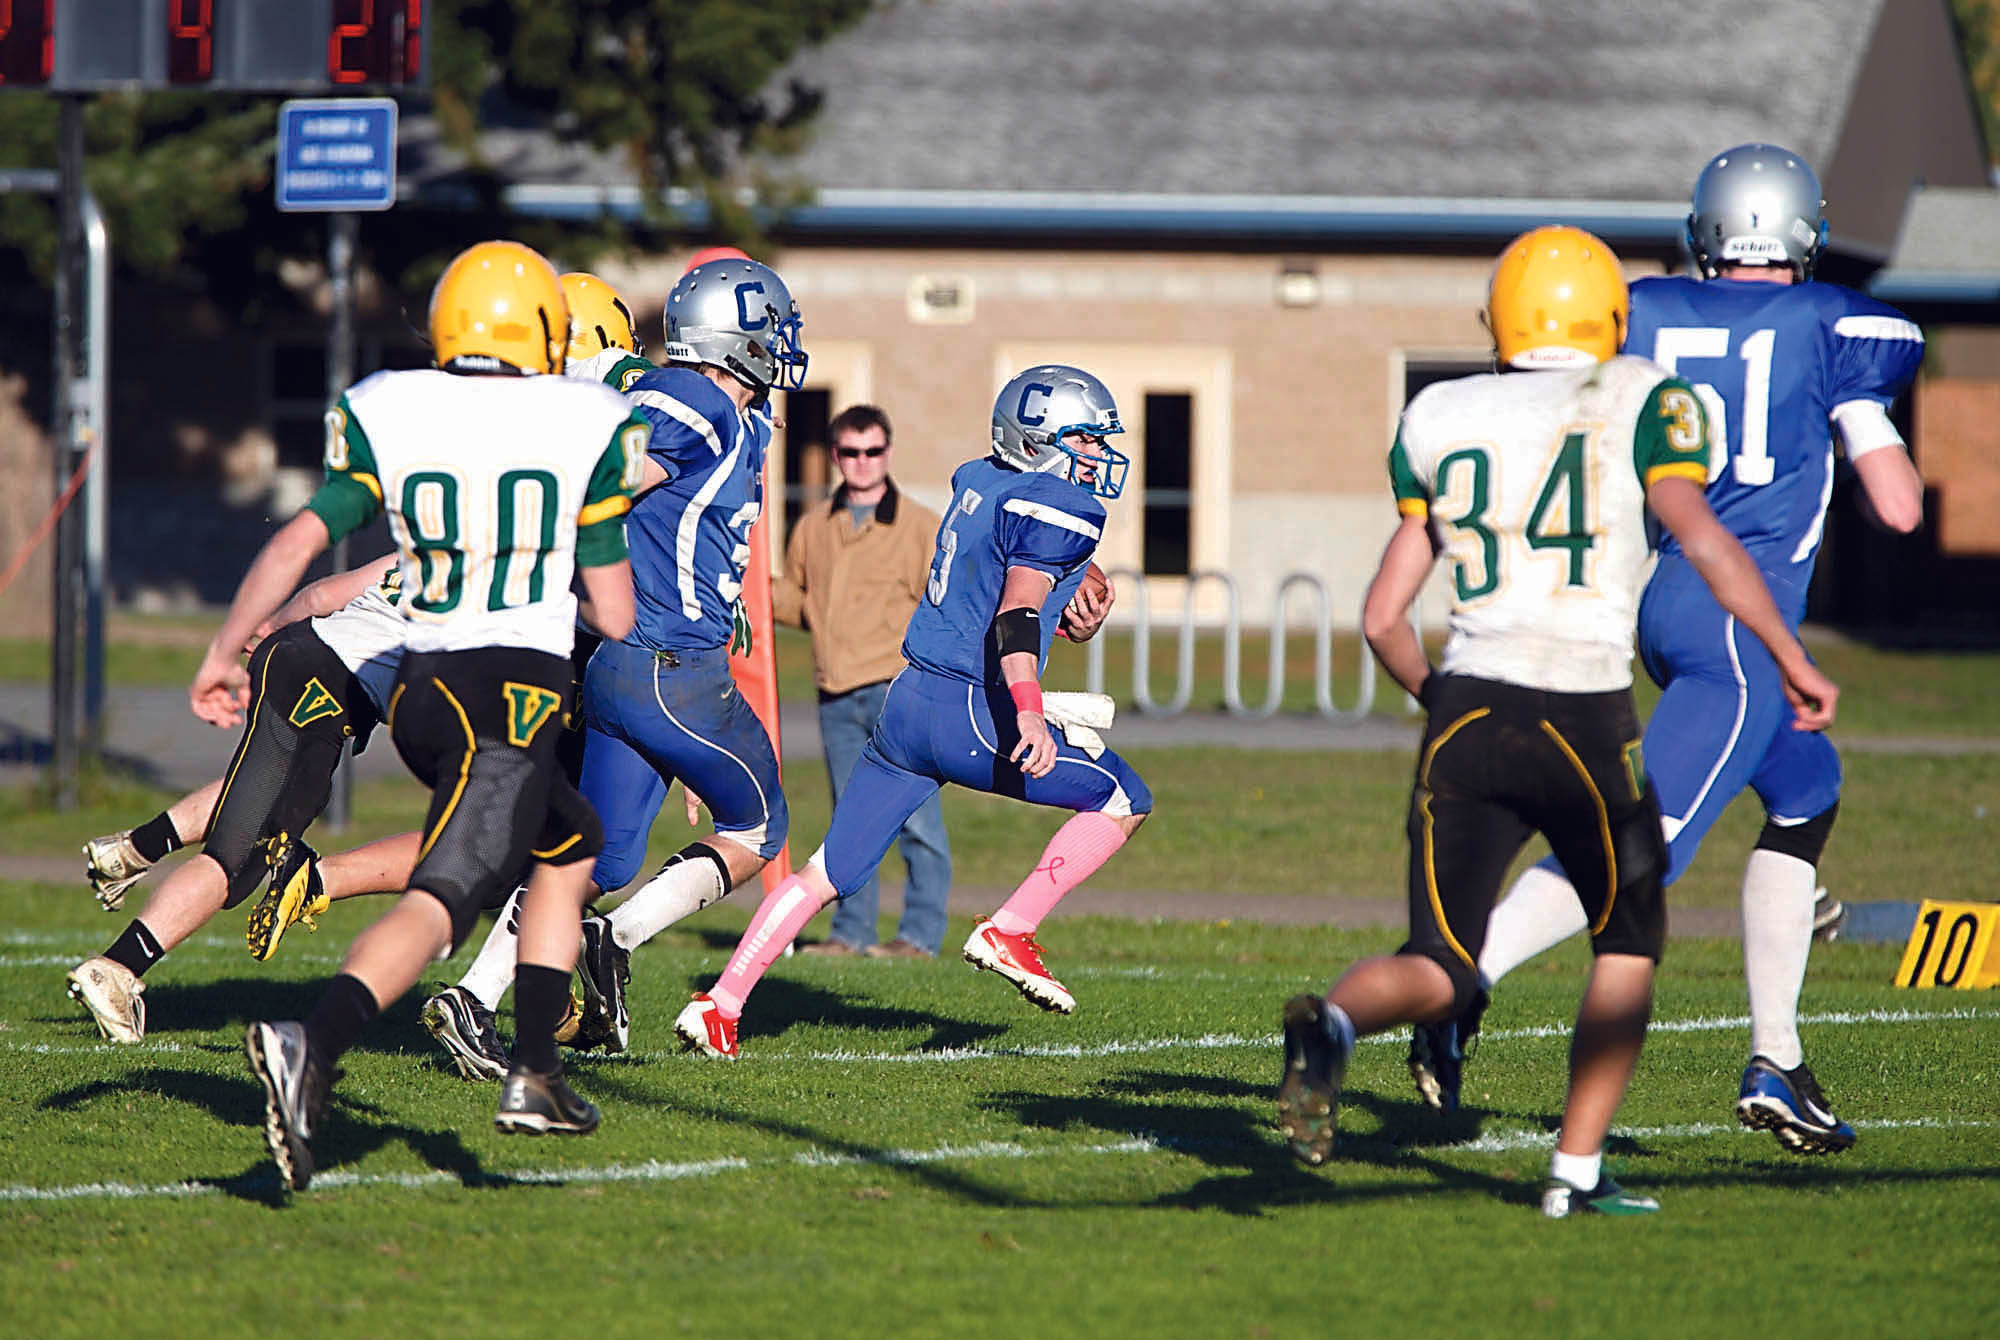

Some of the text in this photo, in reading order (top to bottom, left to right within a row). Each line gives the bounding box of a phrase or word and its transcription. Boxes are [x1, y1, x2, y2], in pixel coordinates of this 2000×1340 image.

[734, 281, 769, 331] C
[1017, 383, 1053, 427] C
[1654, 327, 1776, 486] 51
[1657, 389, 1706, 452] 3
[400, 467, 563, 614] 80
[927, 487, 983, 606] 5
[1434, 430, 1599, 604] 34
[288, 677, 344, 728] V
[503, 680, 562, 748] V
[1909, 909, 1978, 987] 10
